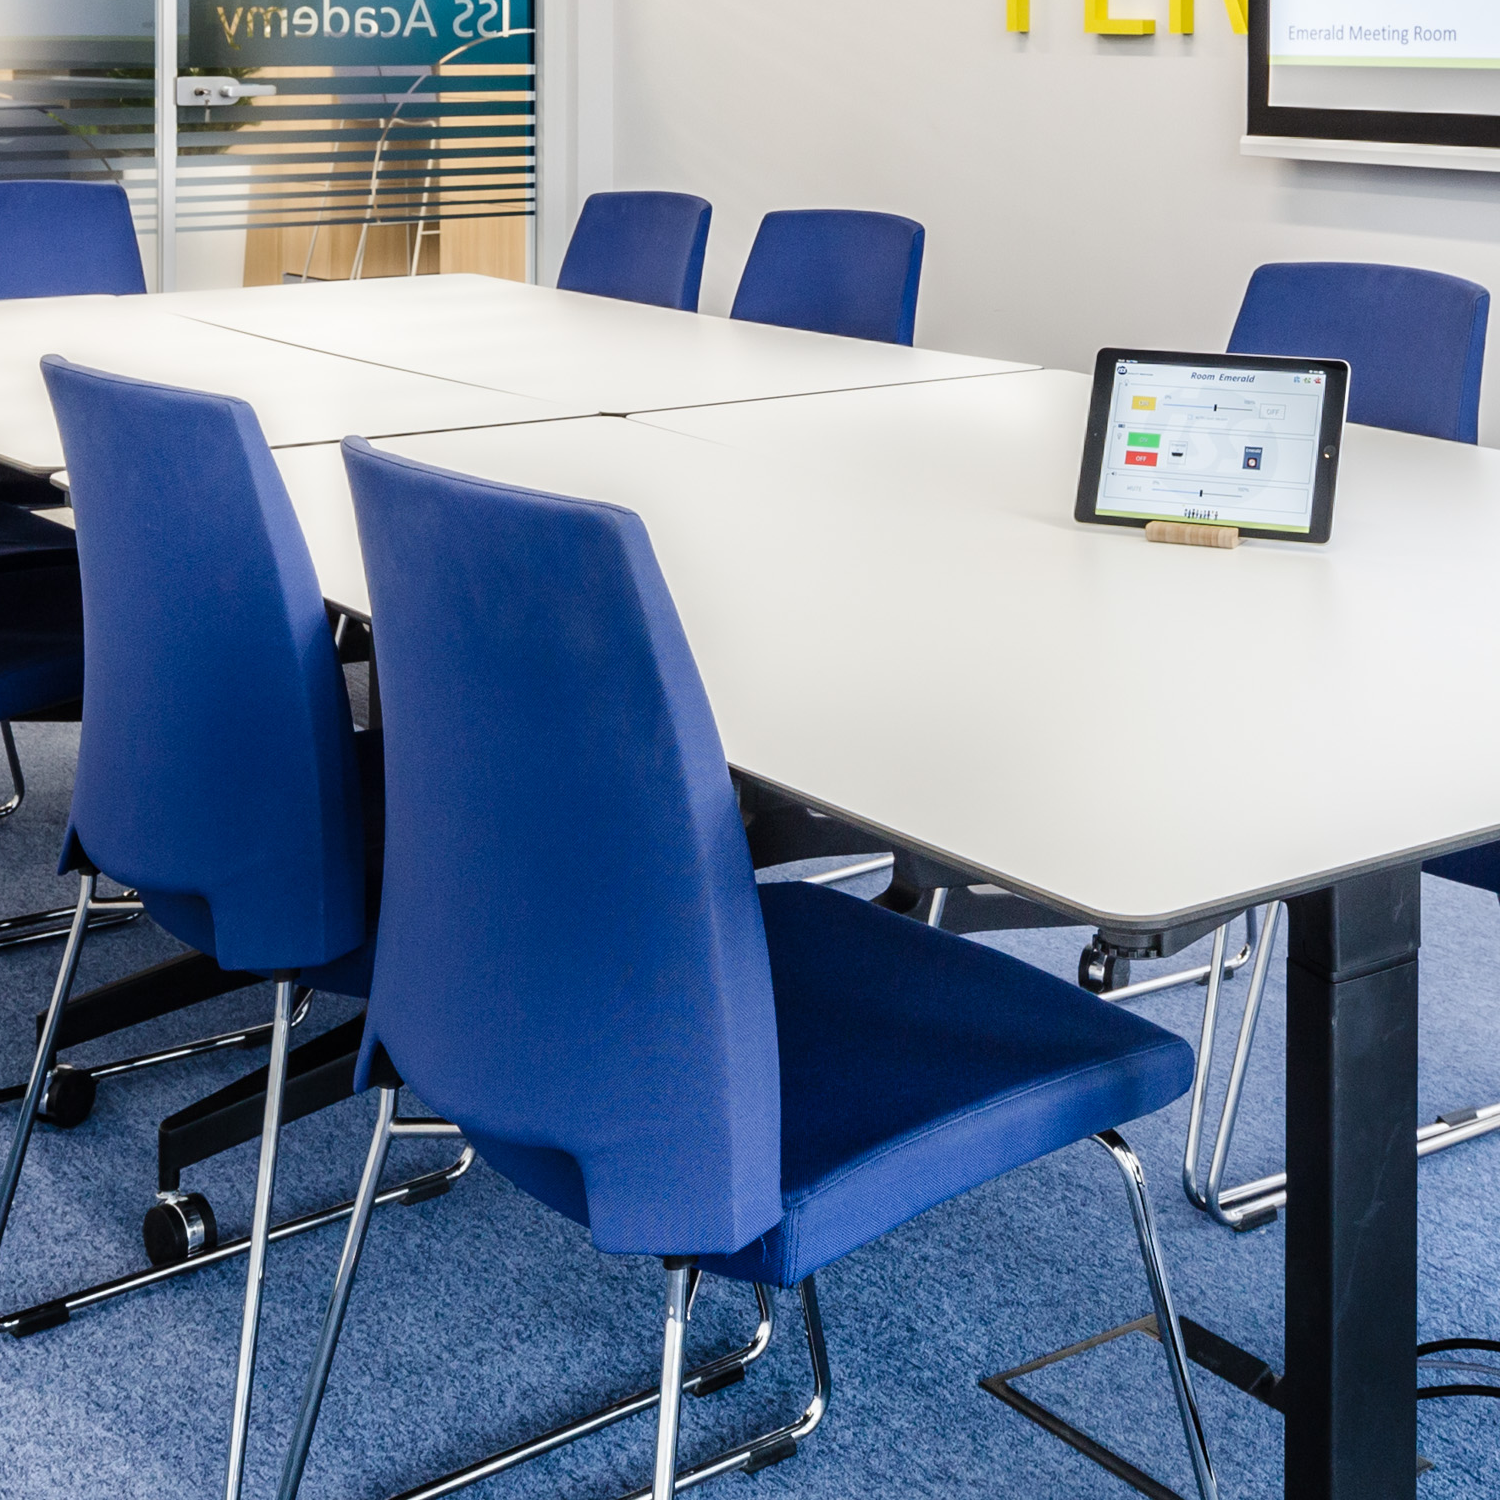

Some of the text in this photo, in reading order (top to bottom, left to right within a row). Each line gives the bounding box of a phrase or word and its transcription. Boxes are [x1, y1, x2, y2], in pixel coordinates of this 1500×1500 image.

[1288, 25, 1458, 45] Emerald Meeting Room
[1191, 371, 1256, 384] Room Emerald
